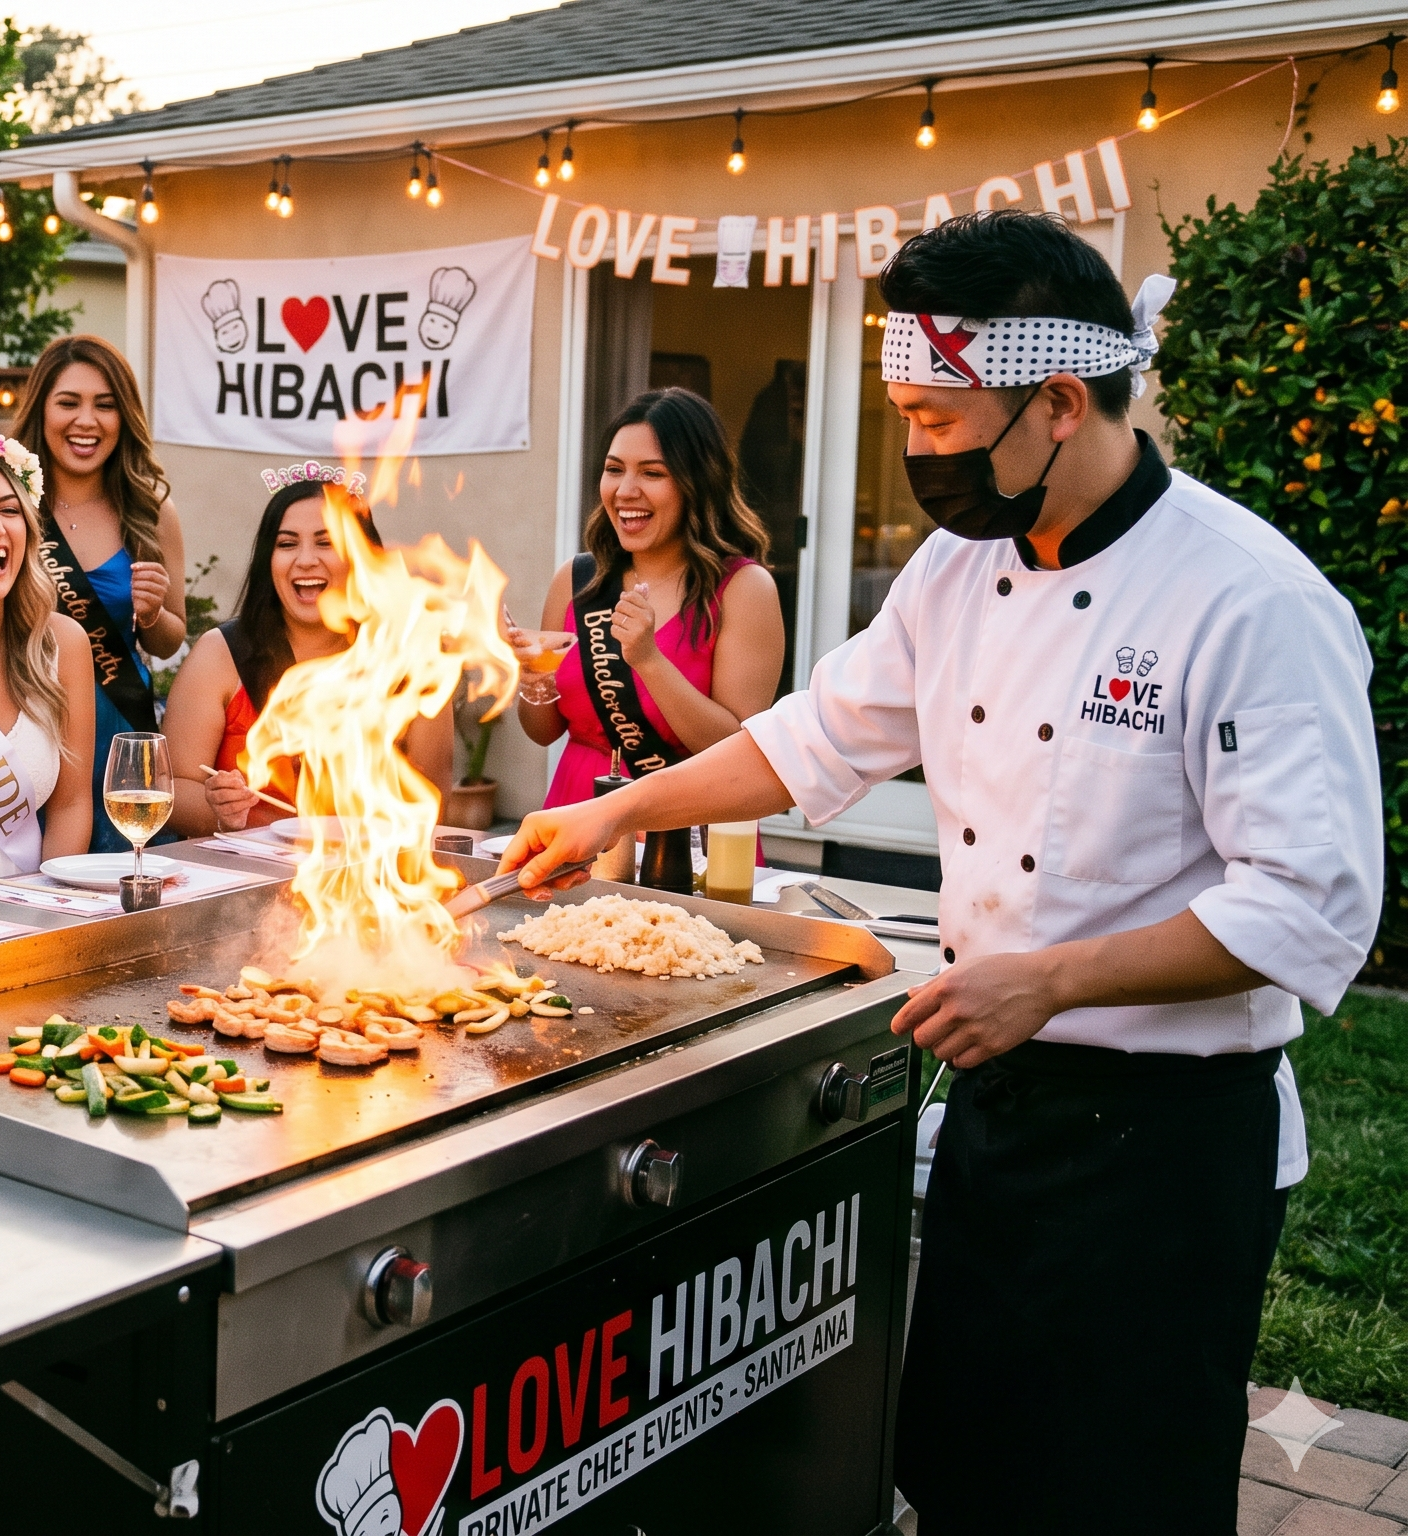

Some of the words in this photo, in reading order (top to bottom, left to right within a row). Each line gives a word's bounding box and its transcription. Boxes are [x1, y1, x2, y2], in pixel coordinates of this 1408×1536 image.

[530, 193, 698, 286] LOVE
[216, 359, 450, 421] HIBACHI
[1081, 701, 1165, 735] HIBACHI
[470, 1309, 633, 1500] LOVE
[647, 1192, 860, 1401] HIBACHI
[577, 1438, 636, 1496] CHEF
[643, 1380, 724, 1459] EVENTS
[743, 1338, 805, 1396] SANTA
[811, 1308, 849, 1361] ANA
